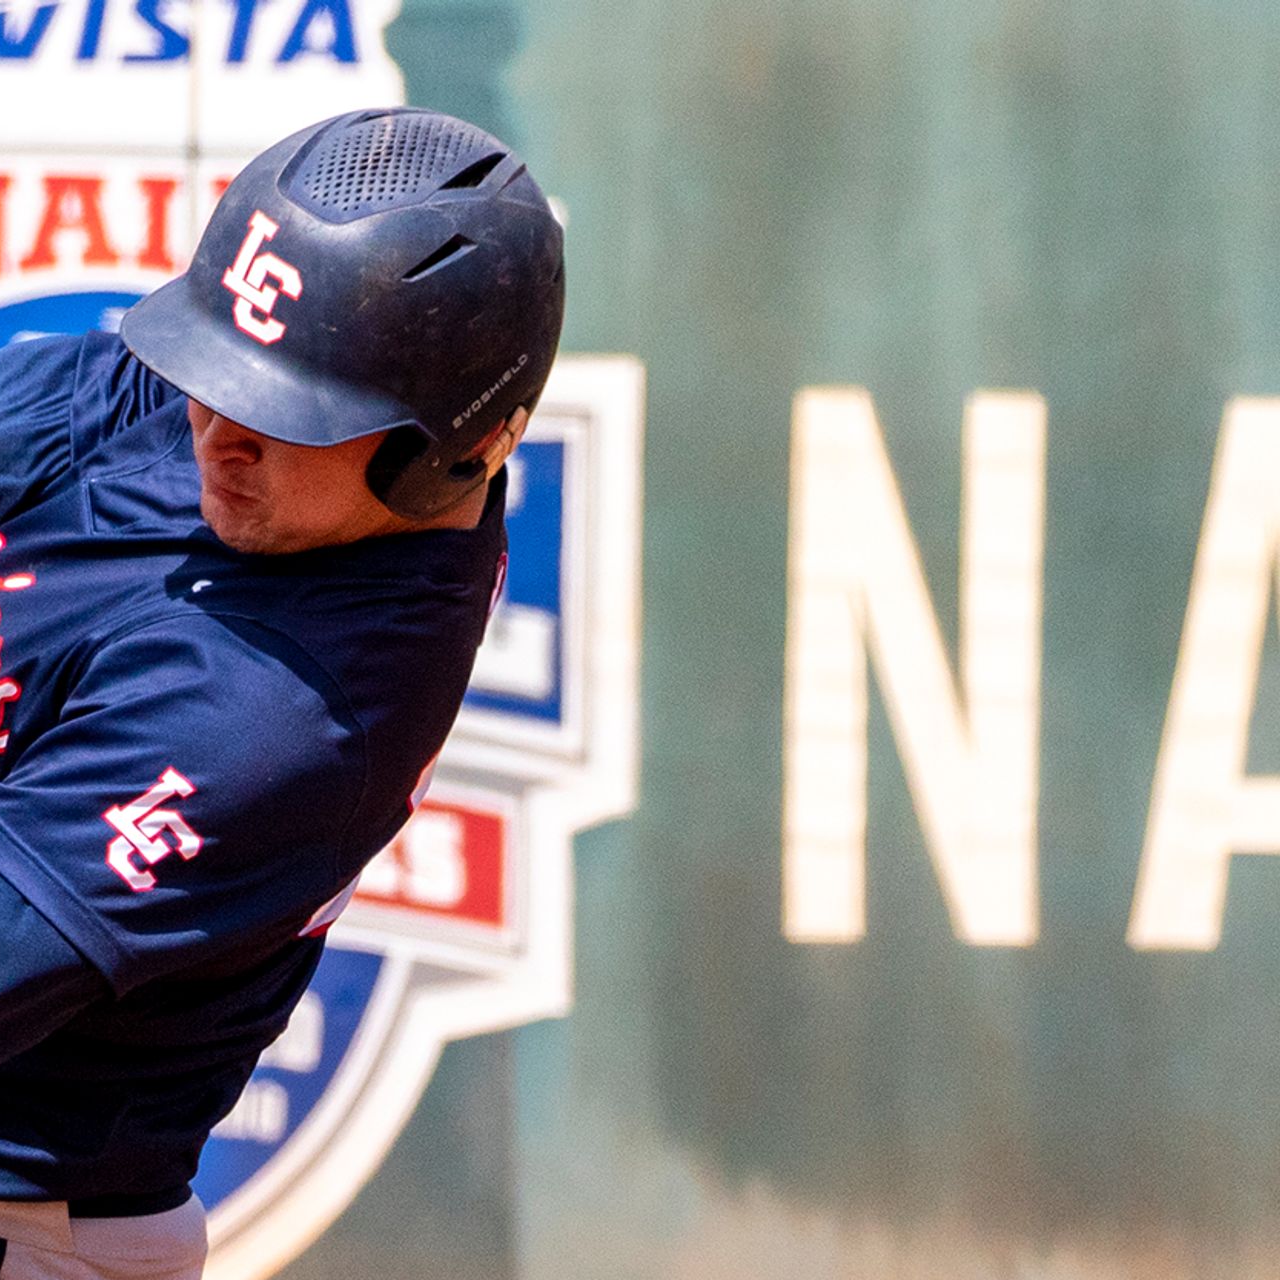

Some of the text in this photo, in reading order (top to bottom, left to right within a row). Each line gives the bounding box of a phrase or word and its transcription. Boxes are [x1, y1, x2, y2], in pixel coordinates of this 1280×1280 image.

[220, 209, 304, 346] LC
[452, 353, 529, 430] EVOSHIELD
[100, 765, 205, 892] LC
